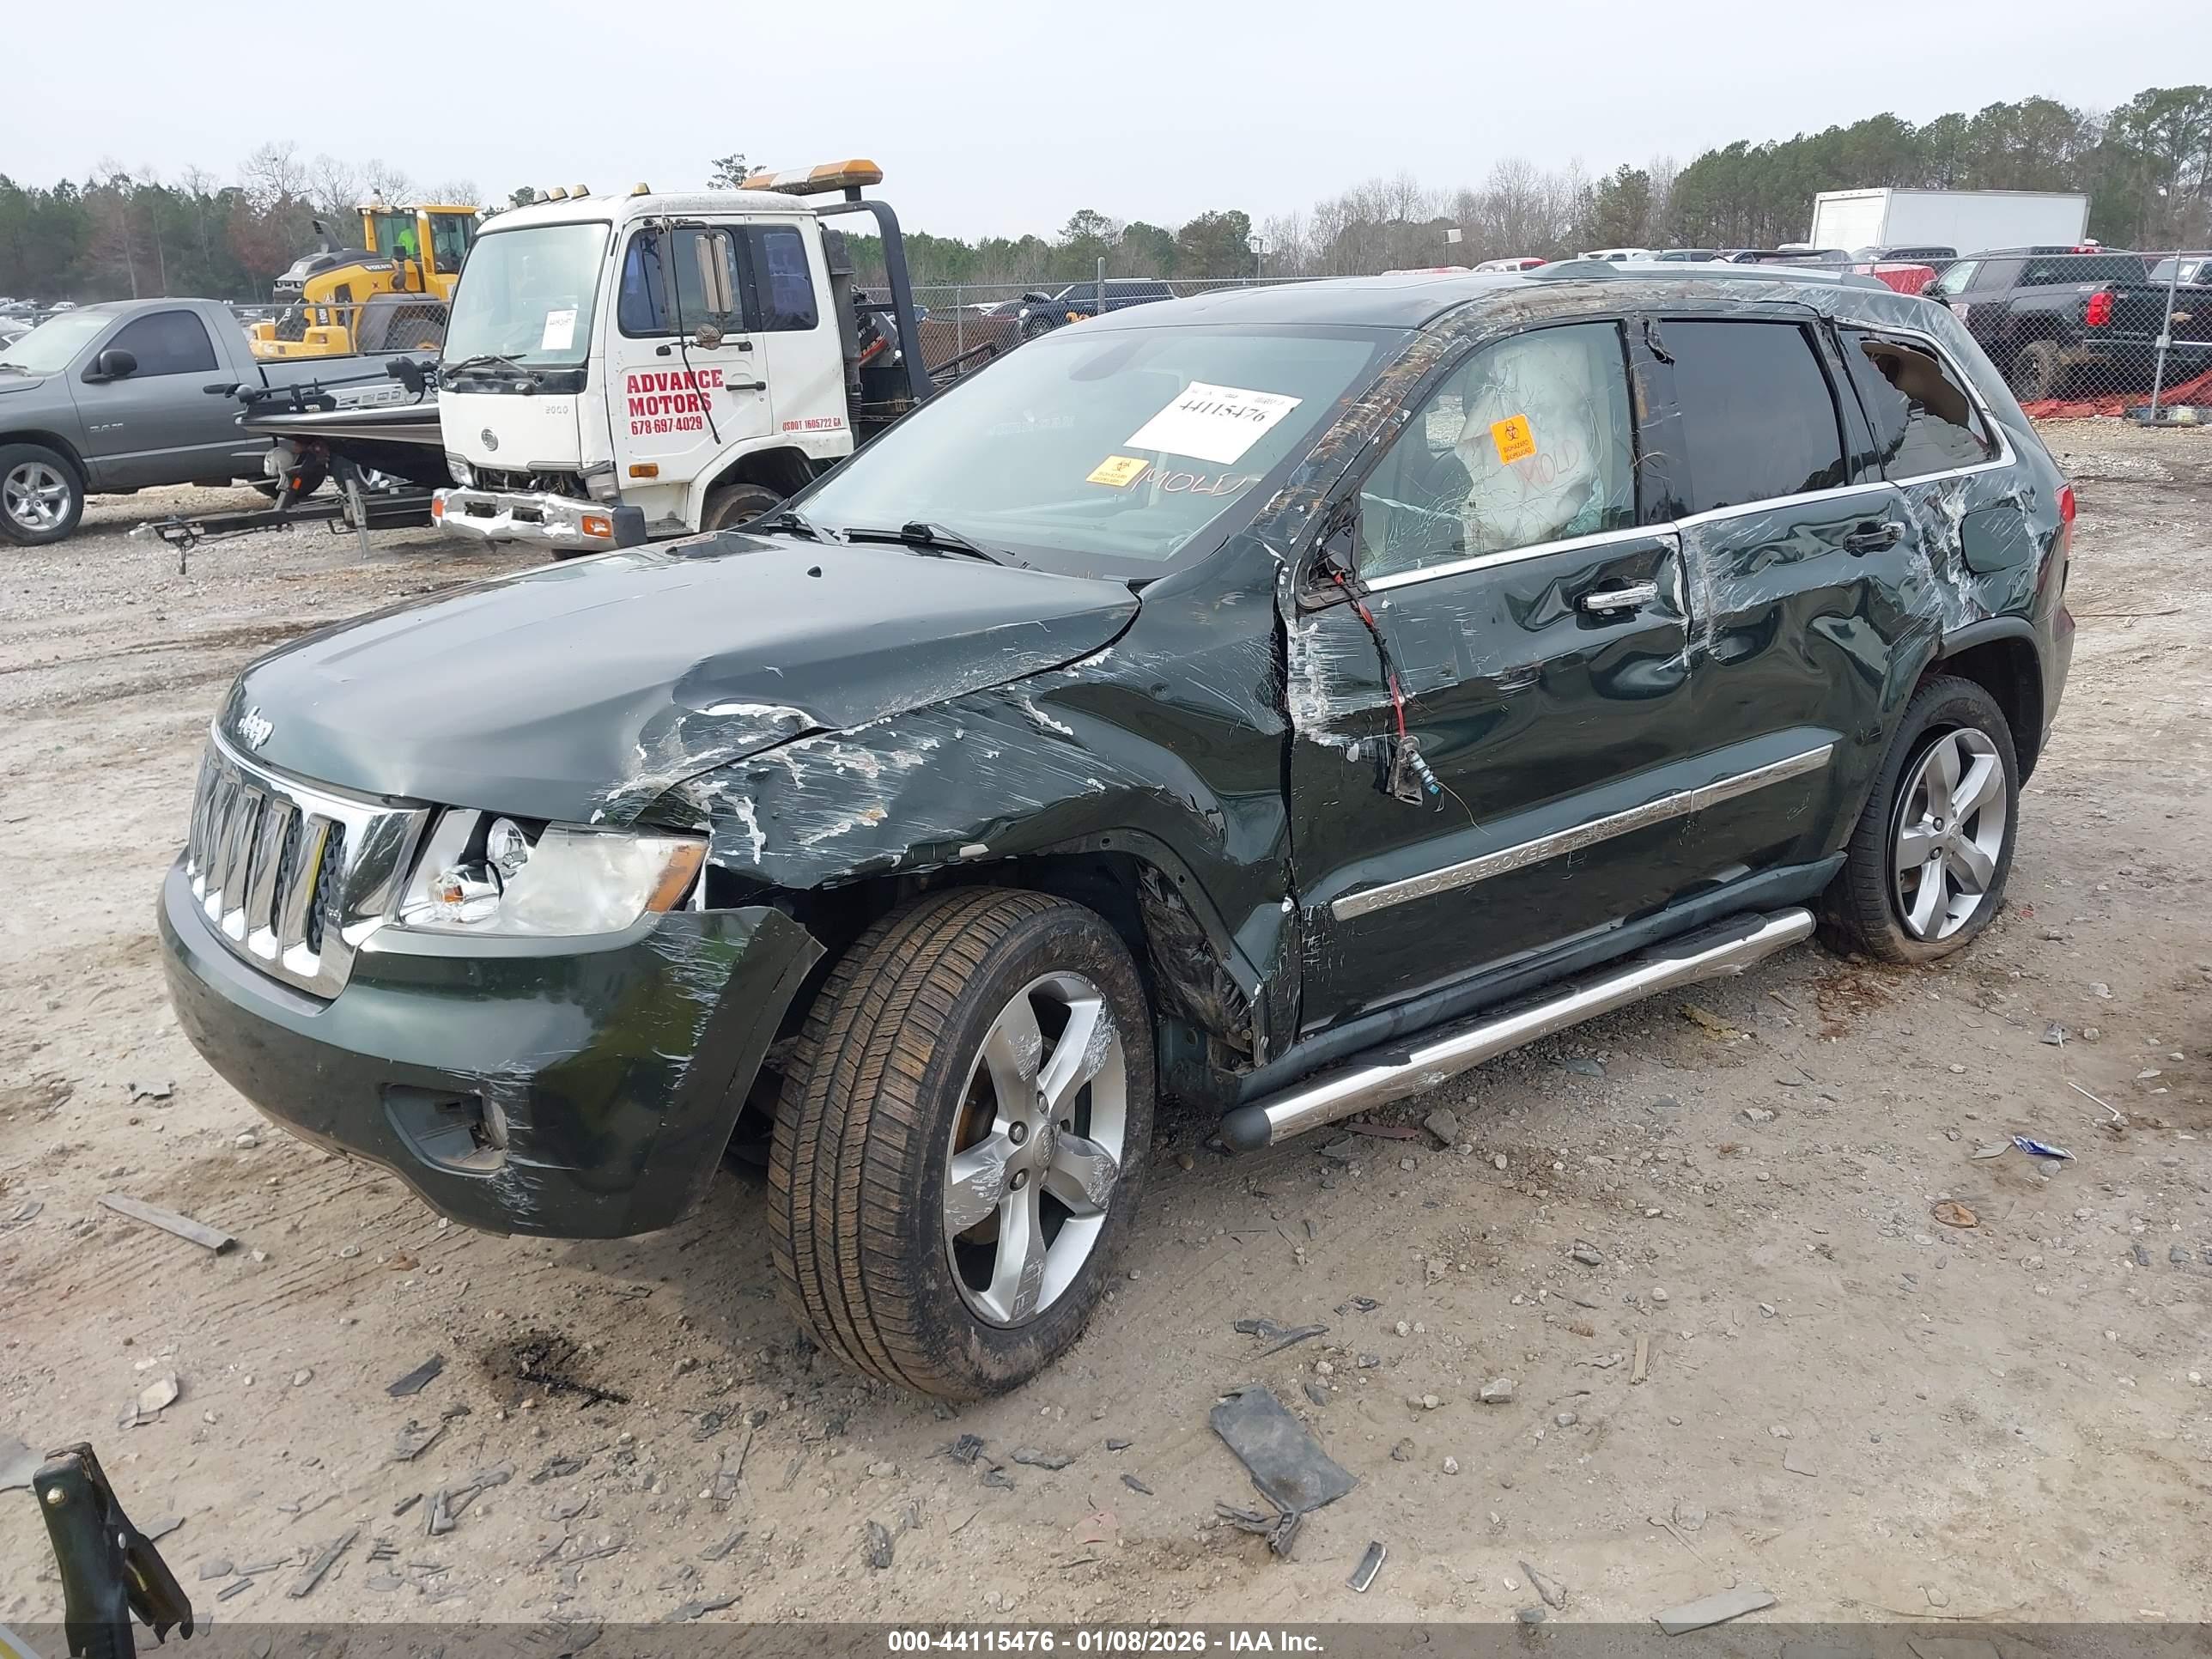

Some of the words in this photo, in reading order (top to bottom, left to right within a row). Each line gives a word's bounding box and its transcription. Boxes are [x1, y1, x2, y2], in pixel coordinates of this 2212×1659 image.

[627, 368, 724, 394] ADVANCE
[628, 392, 712, 417] MOTORS
[1179, 399, 1269, 422] 44115476
[631, 415, 703, 436] 678-697-4029
[782, 420, 802, 431] USDOT
[805, 417, 832, 428] 1605722
[1502, 439, 1529, 453] BIOHAZARD
[1130, 468, 1248, 497] MOLD
[237, 706, 274, 750] Jeep
[1368, 874, 1445, 910] GRAND
[1449, 840, 1551, 886] CHEROKEE
